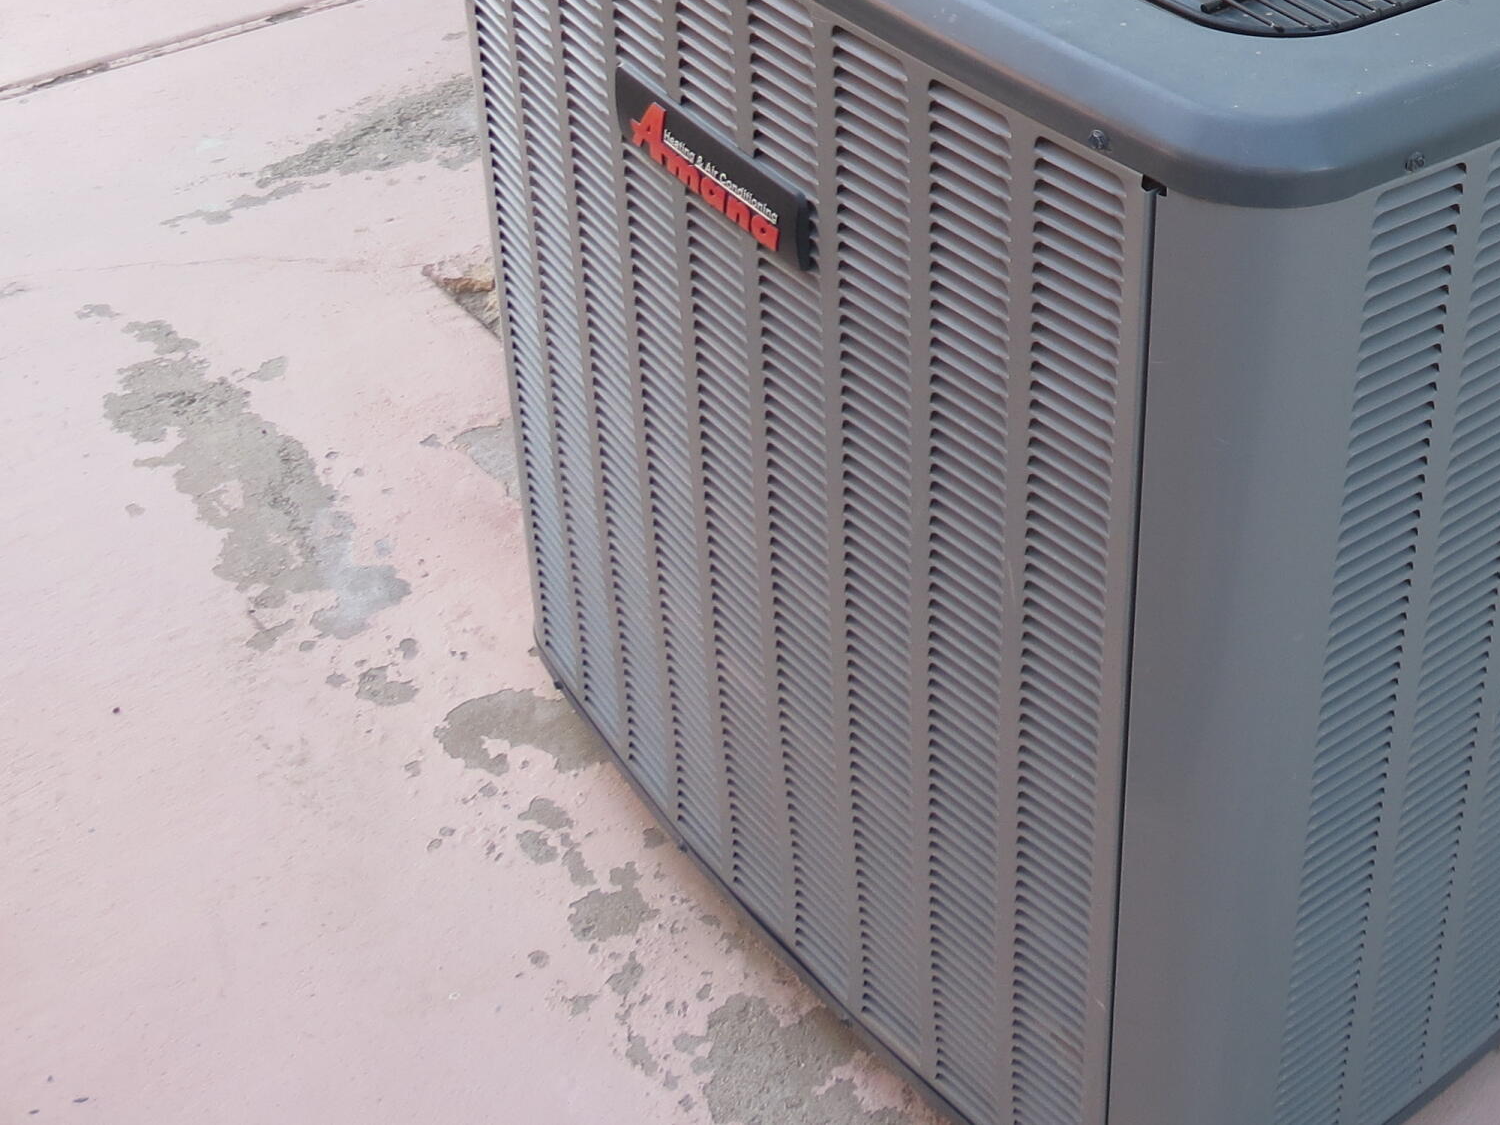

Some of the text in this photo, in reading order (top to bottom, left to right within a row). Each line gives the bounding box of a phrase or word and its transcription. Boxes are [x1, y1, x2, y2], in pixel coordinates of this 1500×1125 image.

[630, 102, 780, 252] Amana
[664, 129, 779, 224] Heating & Air Conditioning
